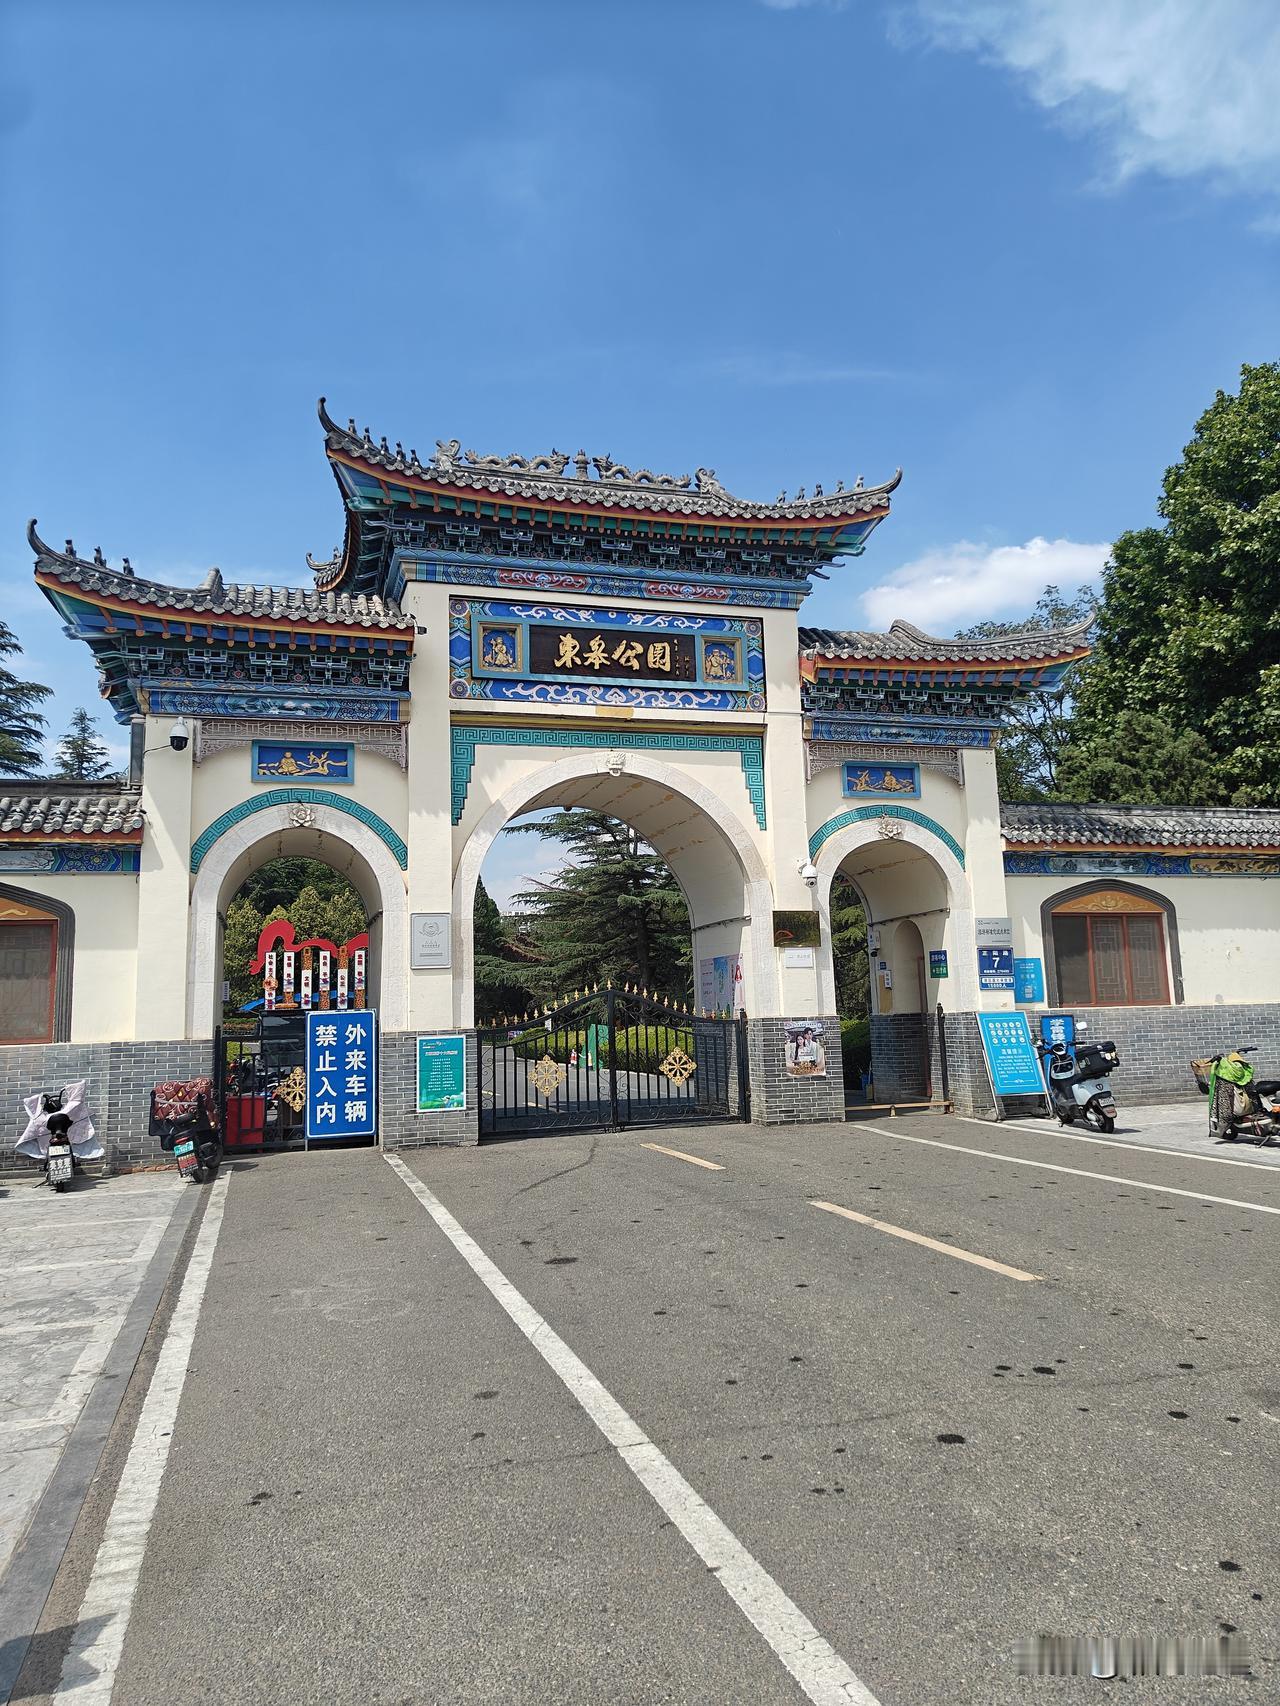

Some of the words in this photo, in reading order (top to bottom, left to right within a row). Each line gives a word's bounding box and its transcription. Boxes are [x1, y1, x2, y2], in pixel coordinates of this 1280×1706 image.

[992, 957, 1000, 968] 7
[1050, 1018, 1066, 1044] 学雷锋
[315, 1024, 338, 1124] 禁止入内
[344, 1023, 367, 1122] 外来车辆
